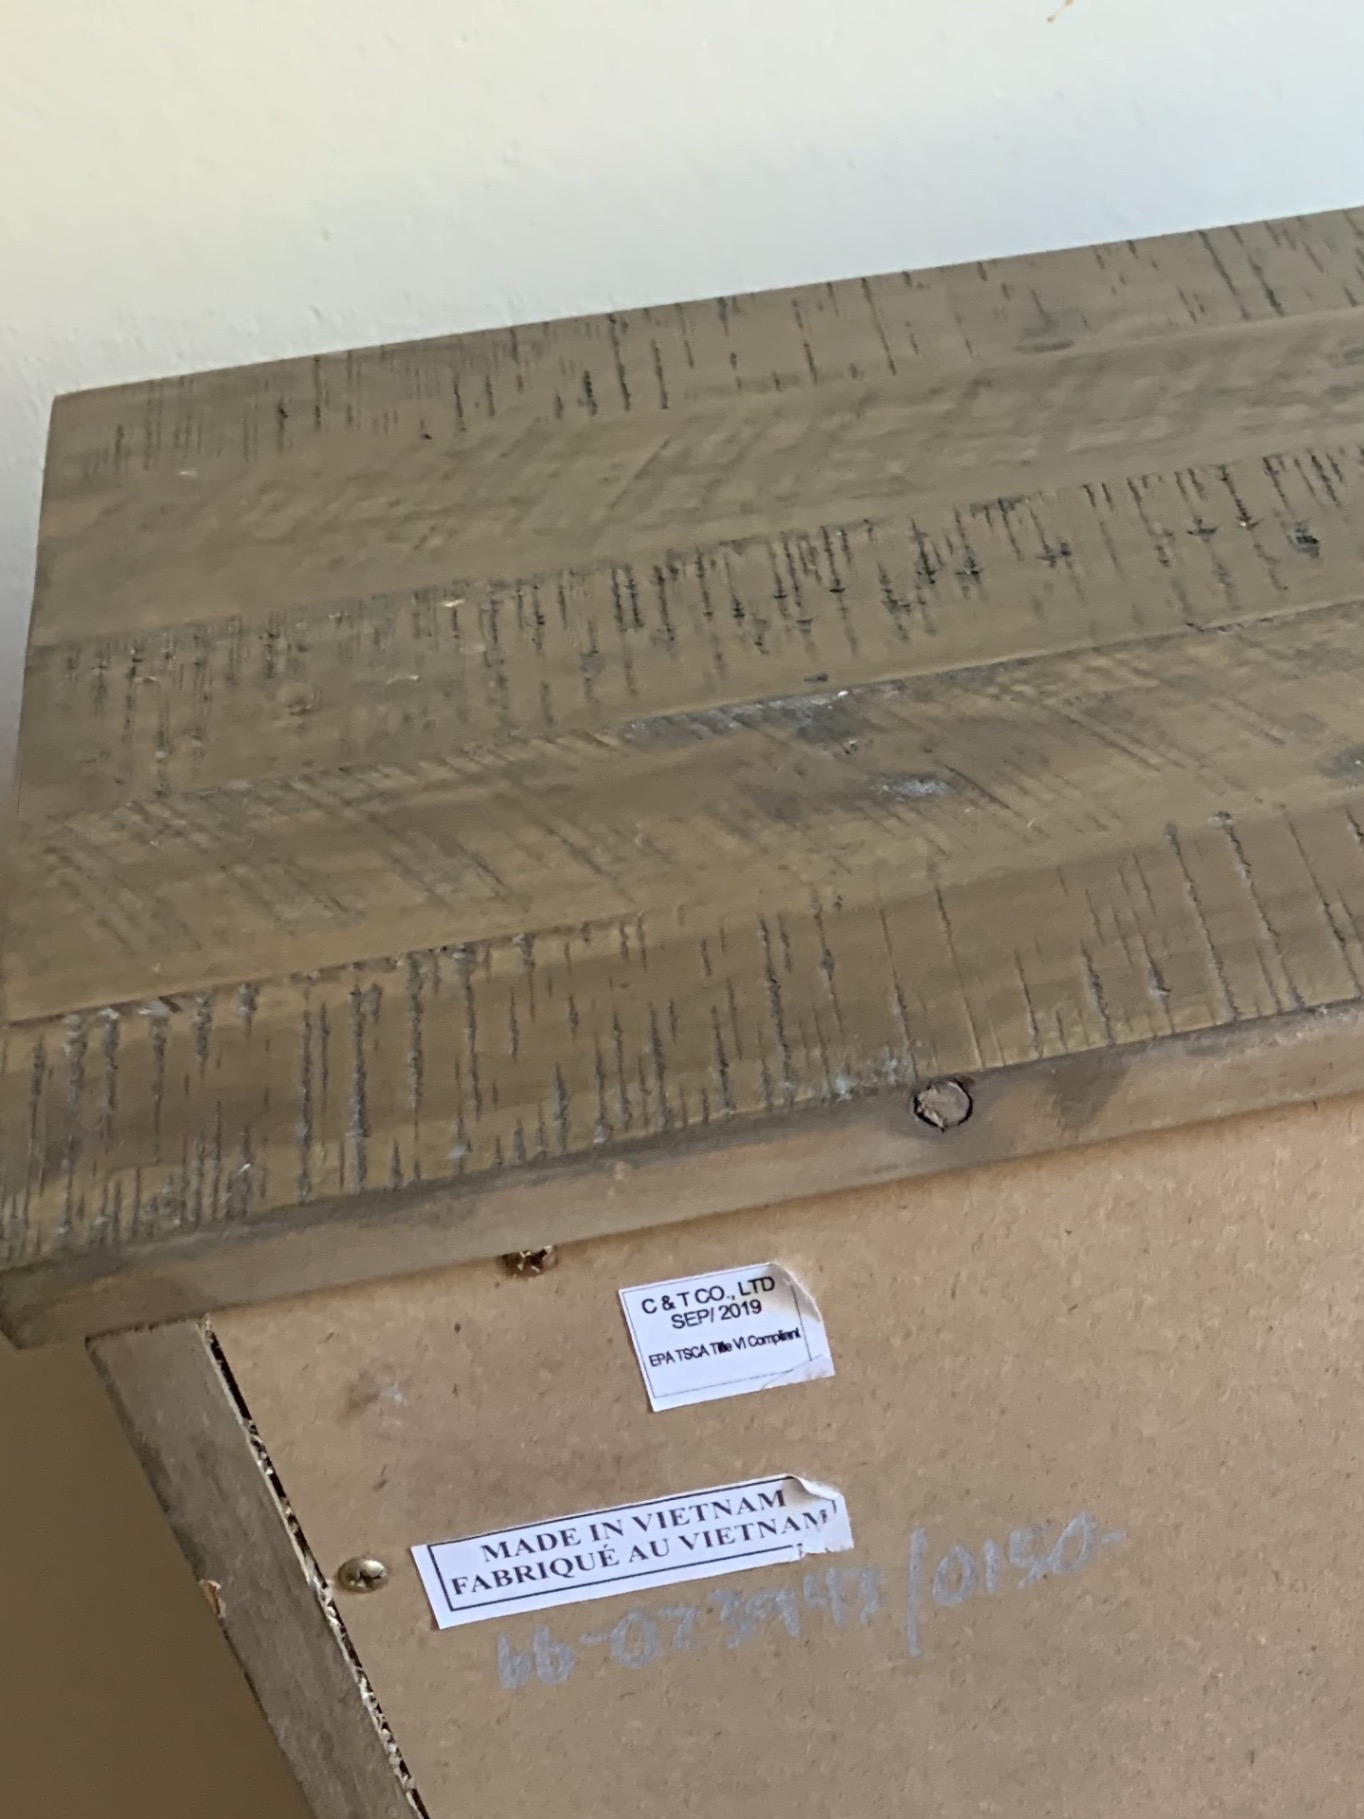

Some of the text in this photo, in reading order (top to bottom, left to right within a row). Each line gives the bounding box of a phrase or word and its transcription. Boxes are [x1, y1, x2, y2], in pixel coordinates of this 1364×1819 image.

[641, 1297, 657, 1314] C
[661, 1294, 676, 1310] &
[676, 1291, 690, 1308] T
[738, 1275, 776, 1297] LTD
[720, 1299, 762, 1320] 2019
[648, 1351, 676, 1368] EPA
[678, 1344, 709, 1361] TSCA
[733, 1336, 747, 1350] VI
[748, 1327, 801, 1346] Compliant
[480, 1489, 787, 1563] MADE IN VIETNAM
[450, 1508, 829, 1597] FABRIQUÉ AU VIETNAM
